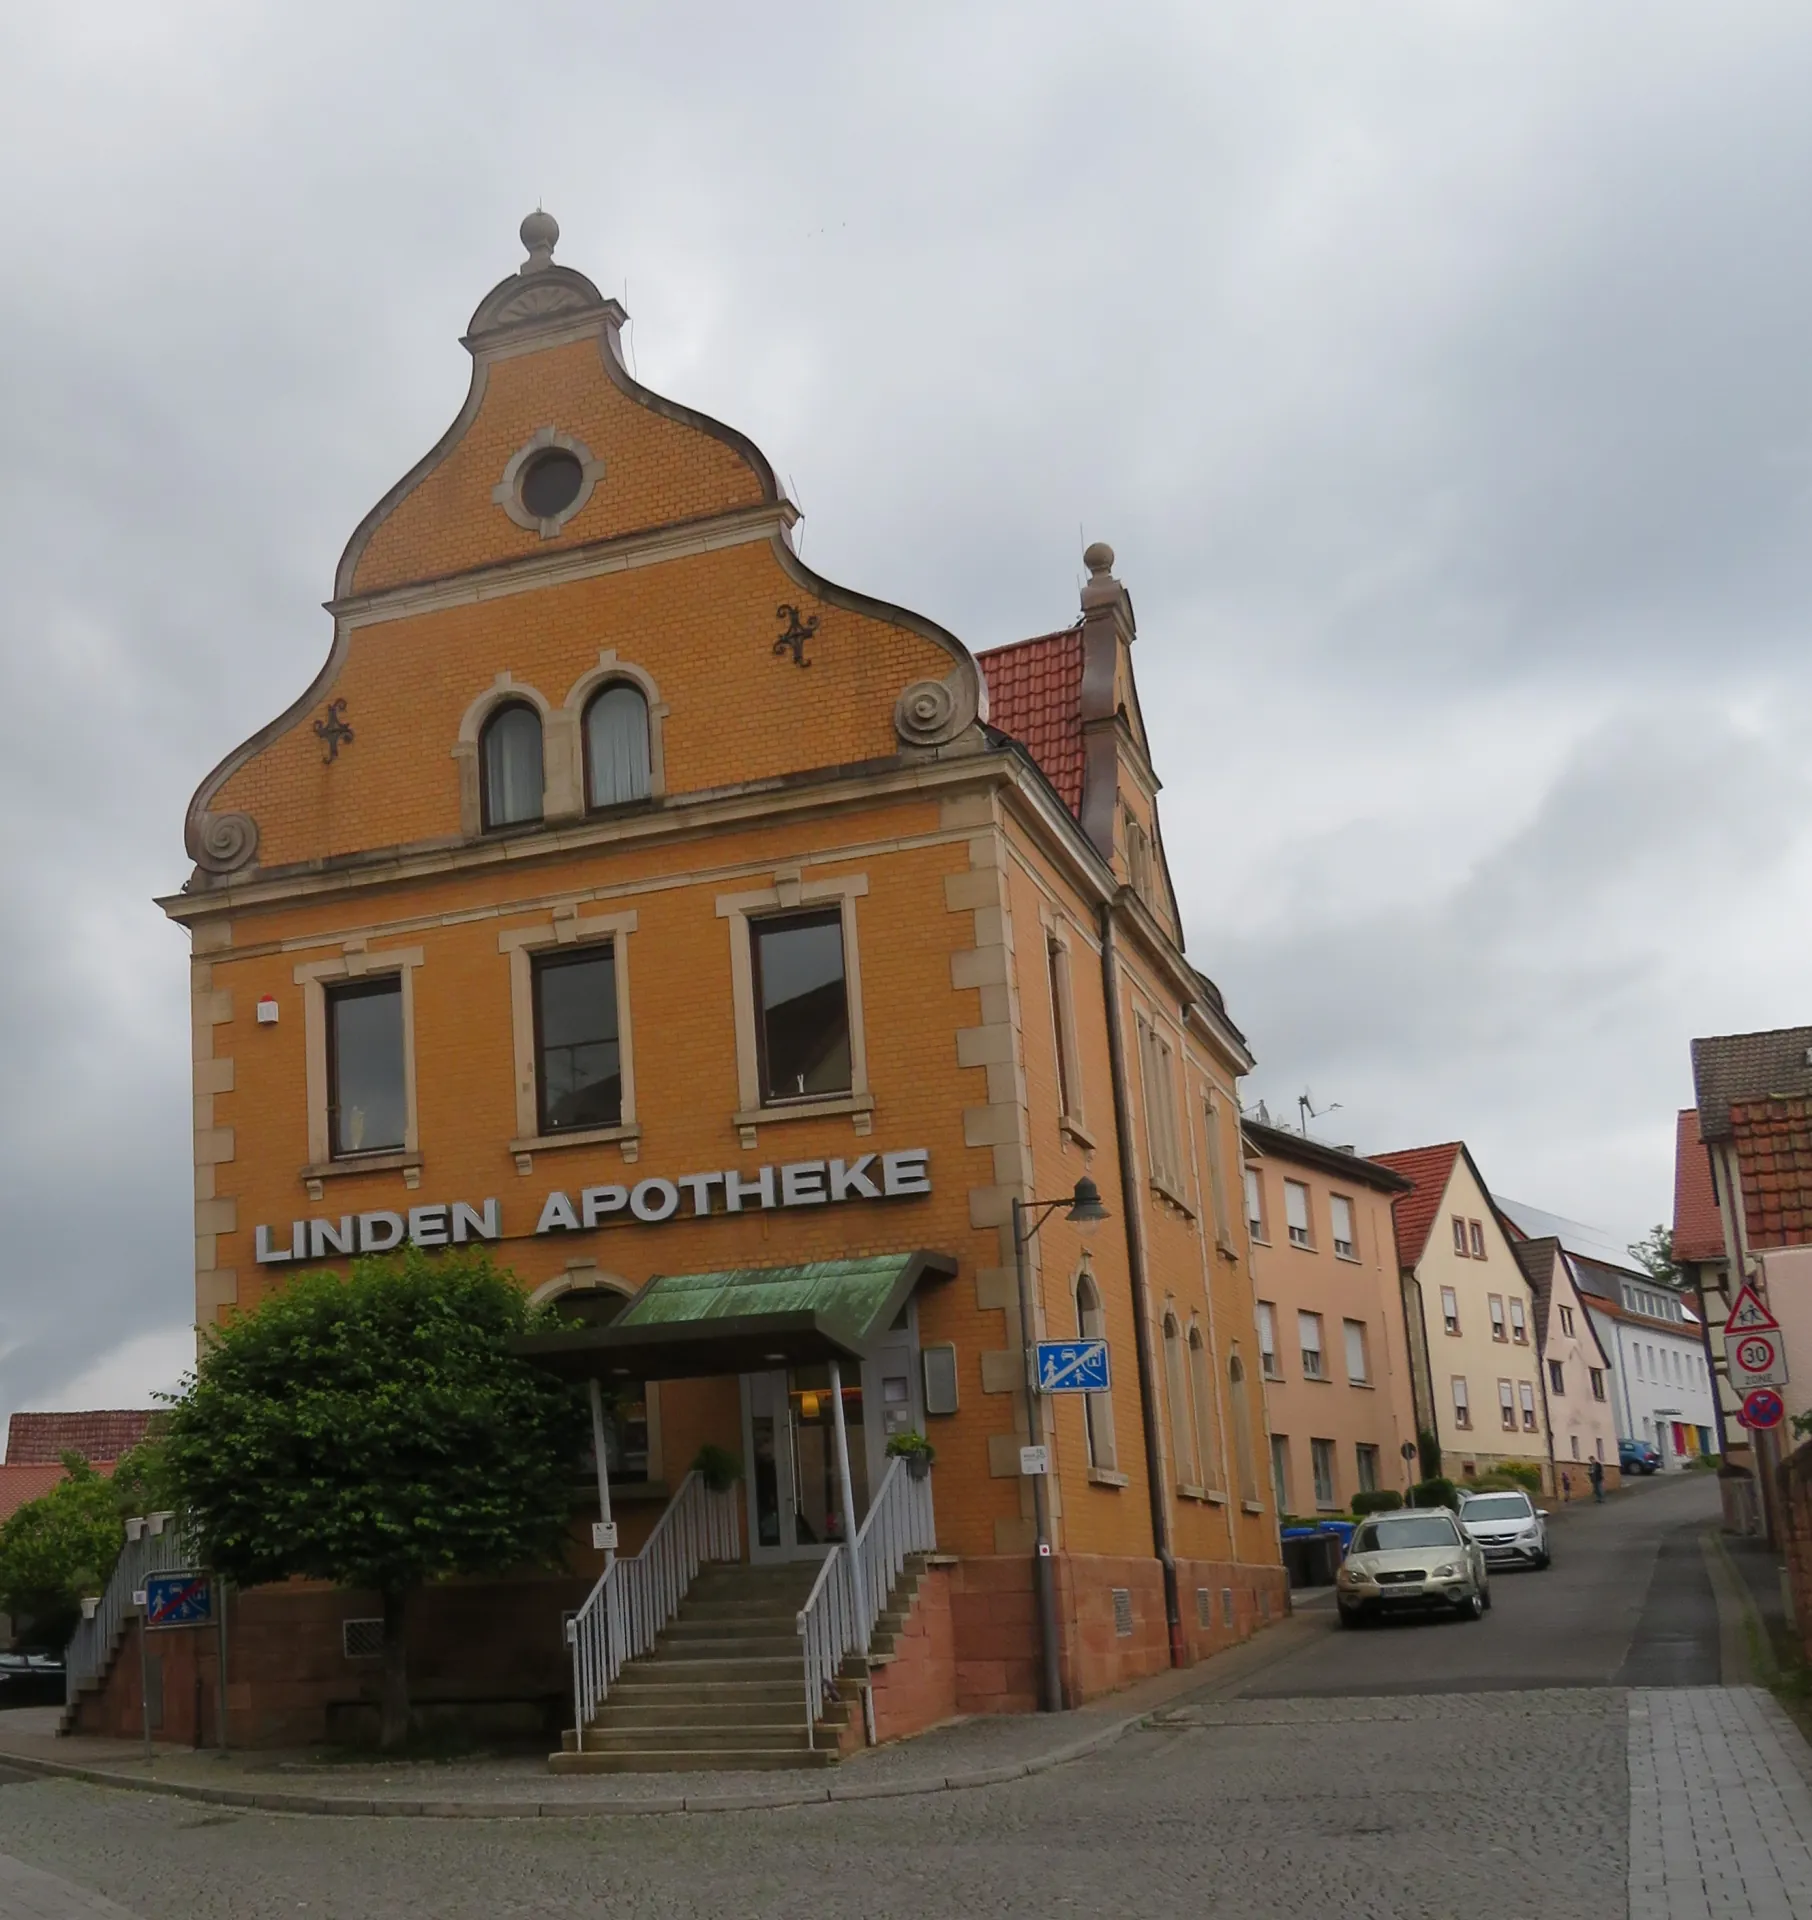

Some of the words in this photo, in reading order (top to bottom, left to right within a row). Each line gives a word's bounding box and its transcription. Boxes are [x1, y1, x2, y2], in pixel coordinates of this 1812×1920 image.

[254, 1197, 500, 1264] LINDEN
[535, 1148, 931, 1232] APOTHEKE
[1743, 1346, 1766, 1363] 30
[1745, 1373, 1773, 1385] ZONE
